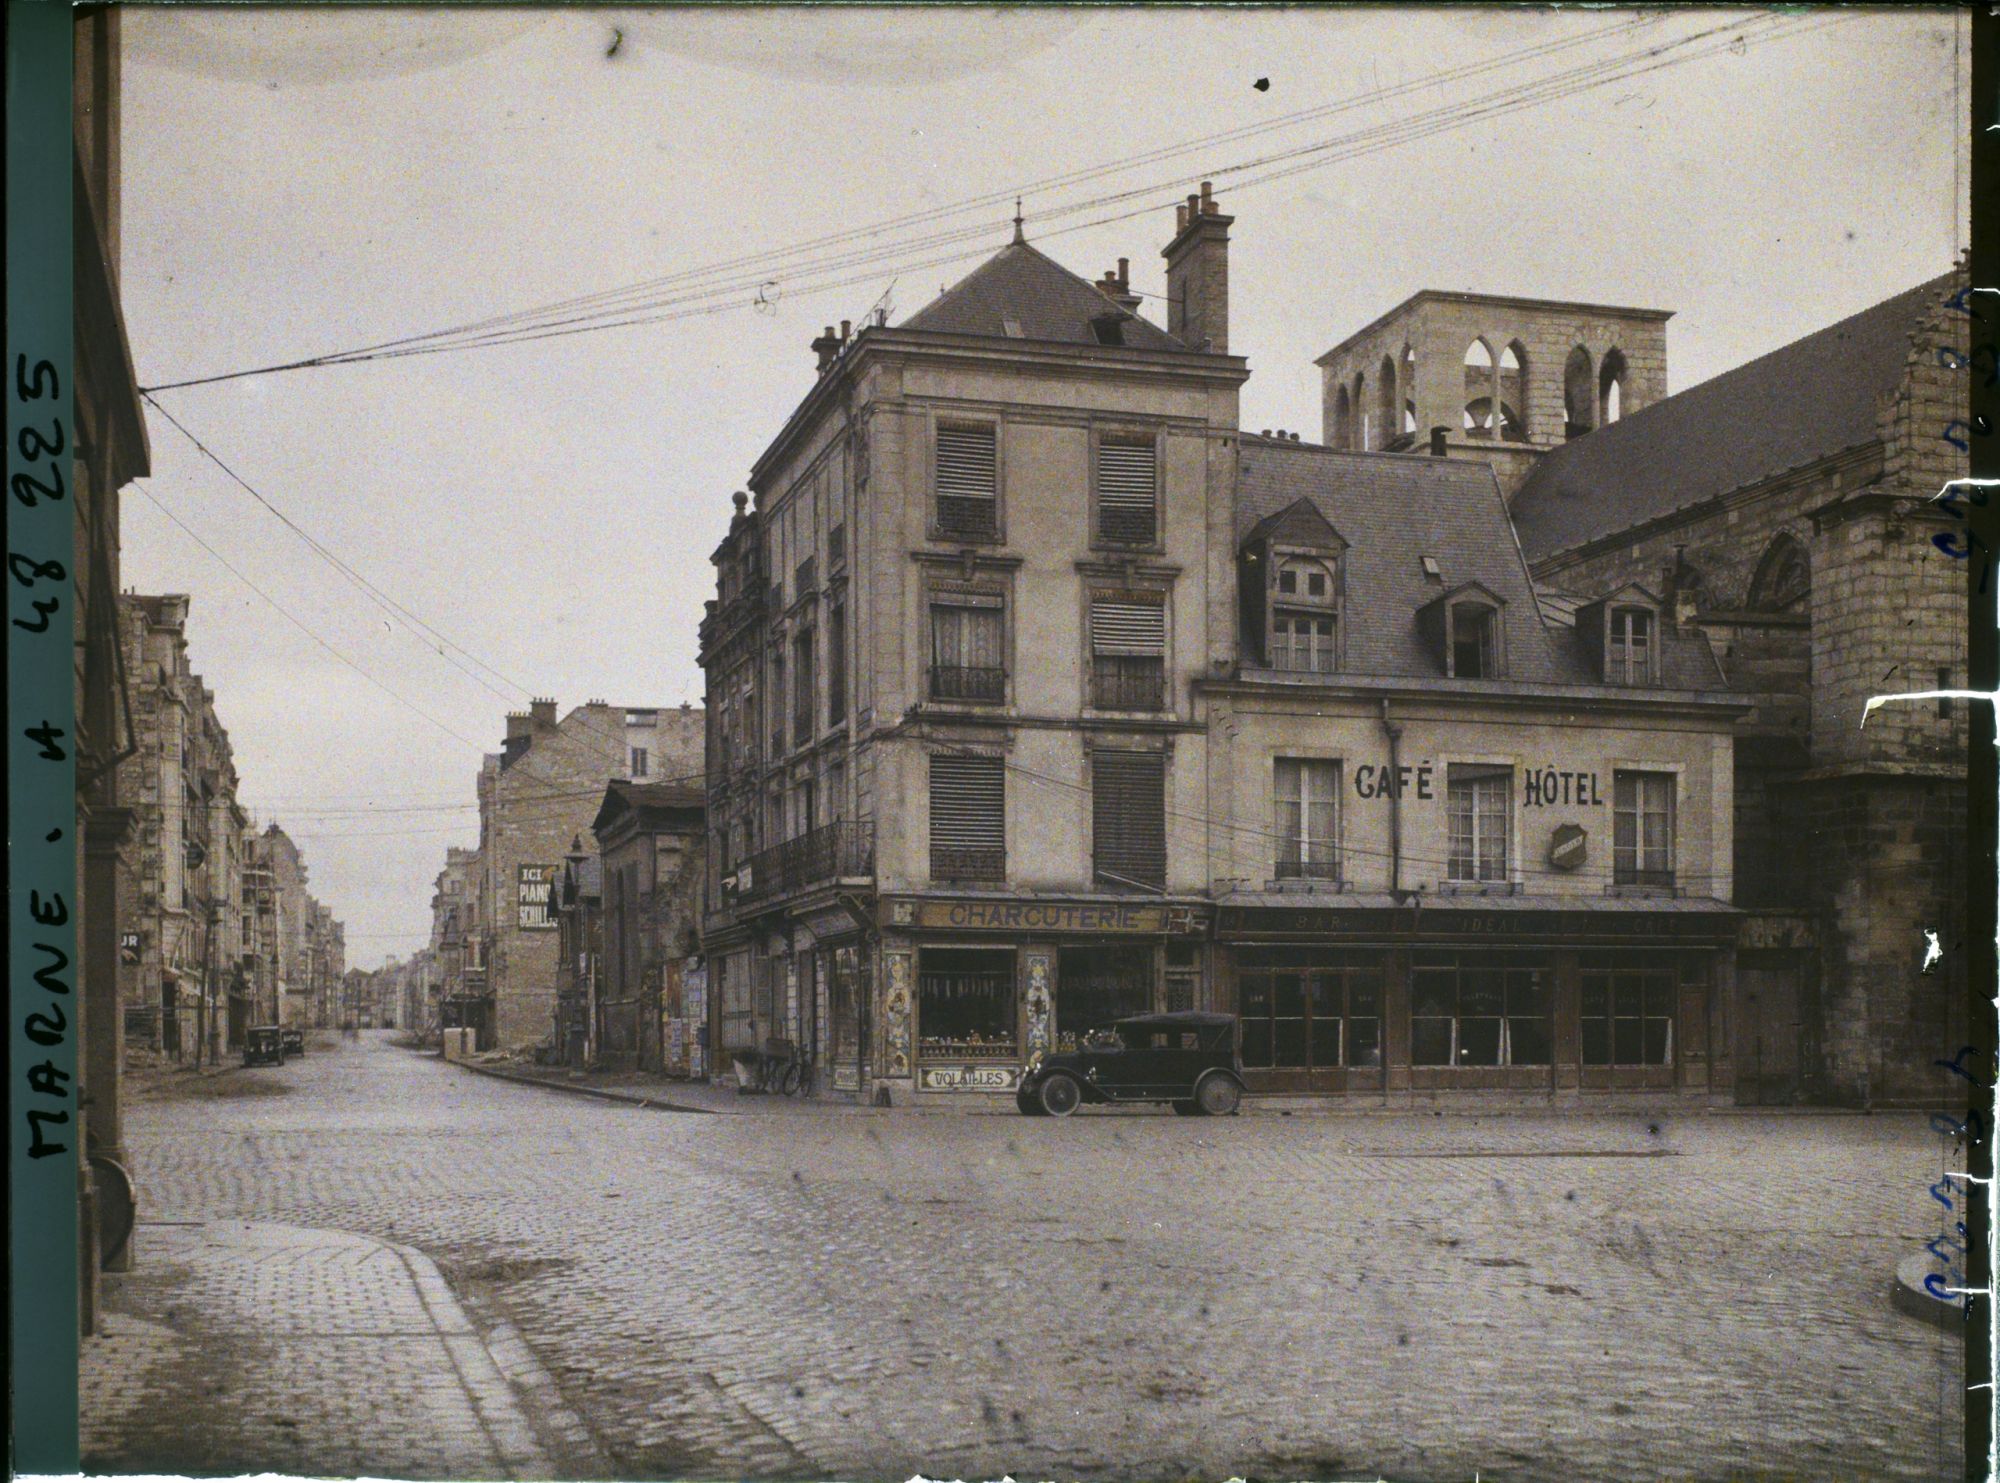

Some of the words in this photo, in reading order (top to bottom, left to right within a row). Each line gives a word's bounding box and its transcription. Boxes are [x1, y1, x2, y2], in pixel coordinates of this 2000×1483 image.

[24, 720, 66, 761] A
[1355, 760, 1433, 800] CAFÉ
[1523, 764, 1602, 807] HÔTEL
[523, 869, 542, 881] ICI
[950, 903, 1139, 930] CHARCUTERIE
[25, 890, 70, 1159] MARNE
[935, 1072, 1004, 1086] VOLAILLES
